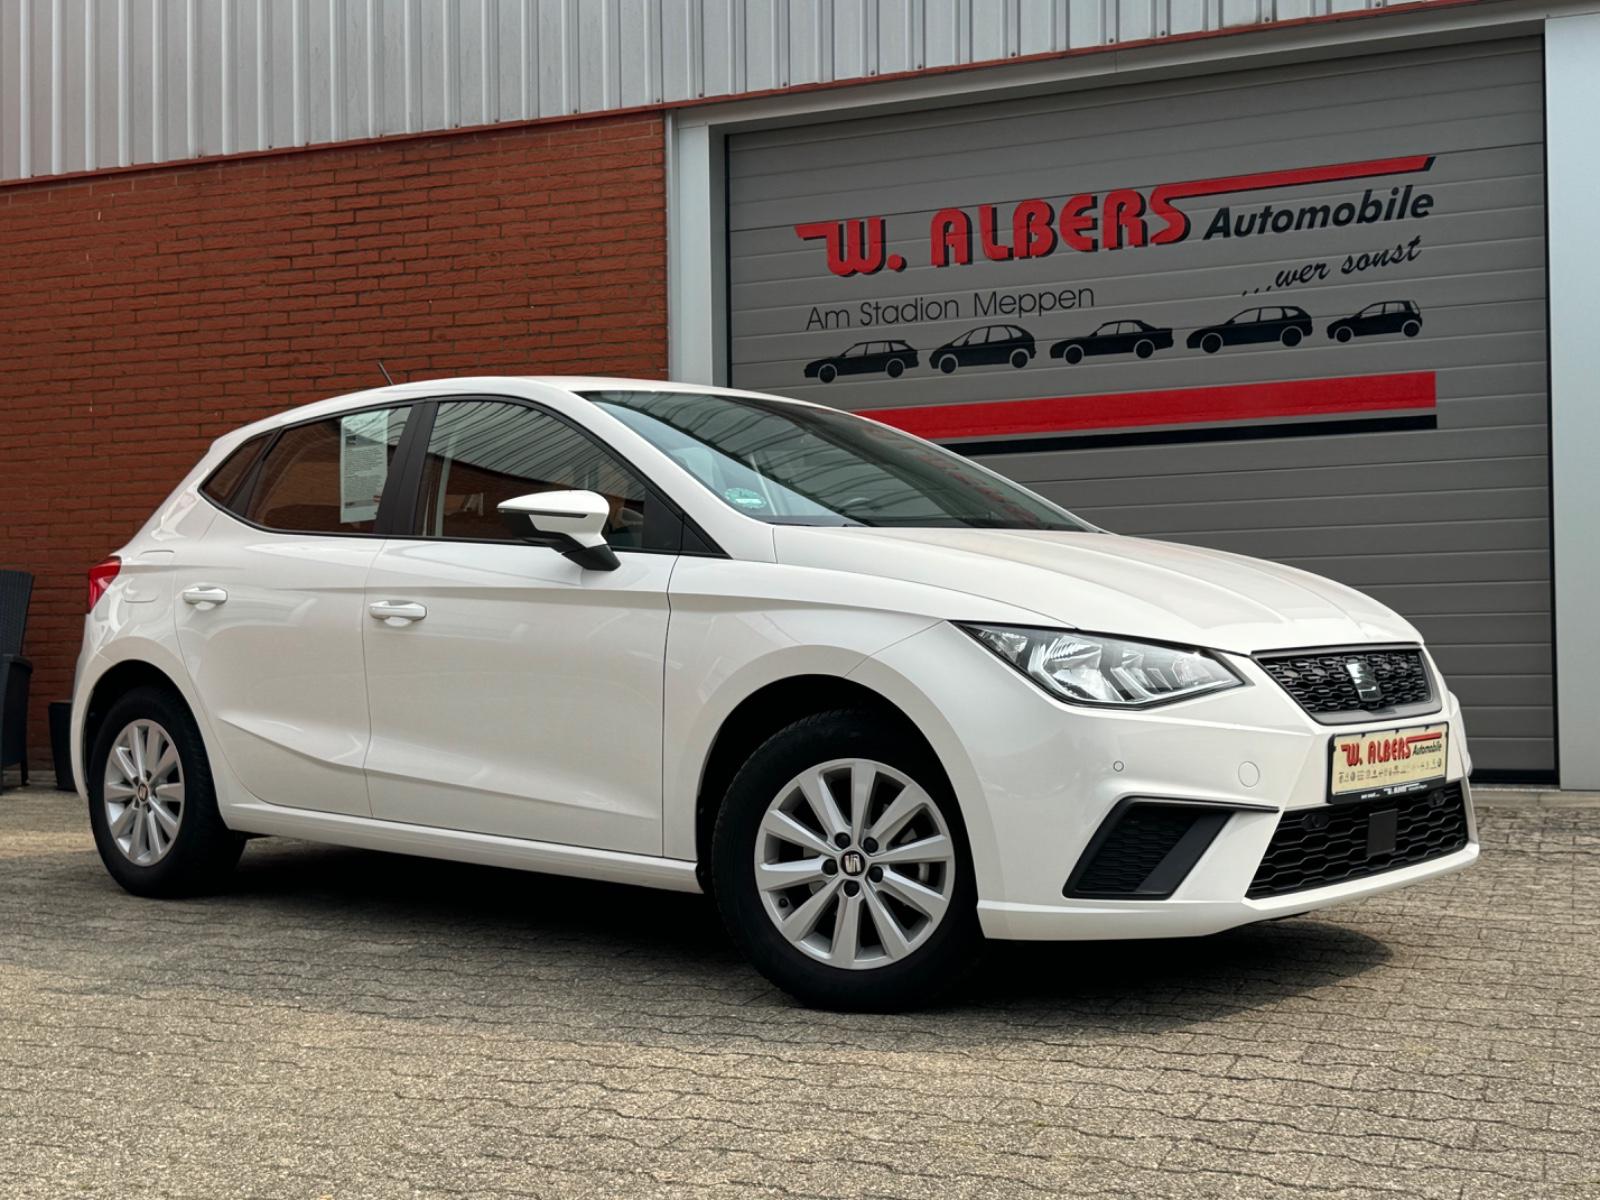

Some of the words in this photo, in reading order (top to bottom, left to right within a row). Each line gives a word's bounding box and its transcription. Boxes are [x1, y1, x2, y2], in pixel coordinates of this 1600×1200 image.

[794, 215, 907, 278] W.
[931, 185, 1191, 268] ALBERS
[1203, 184, 1434, 241] Automobile
[1340, 235, 1422, 274] sonst
[807, 306, 850, 331] Am
[860, 297, 959, 326] Stadion
[974, 286, 1095, 318] Meppen
[1367, 736, 1411, 765] ALBERS
